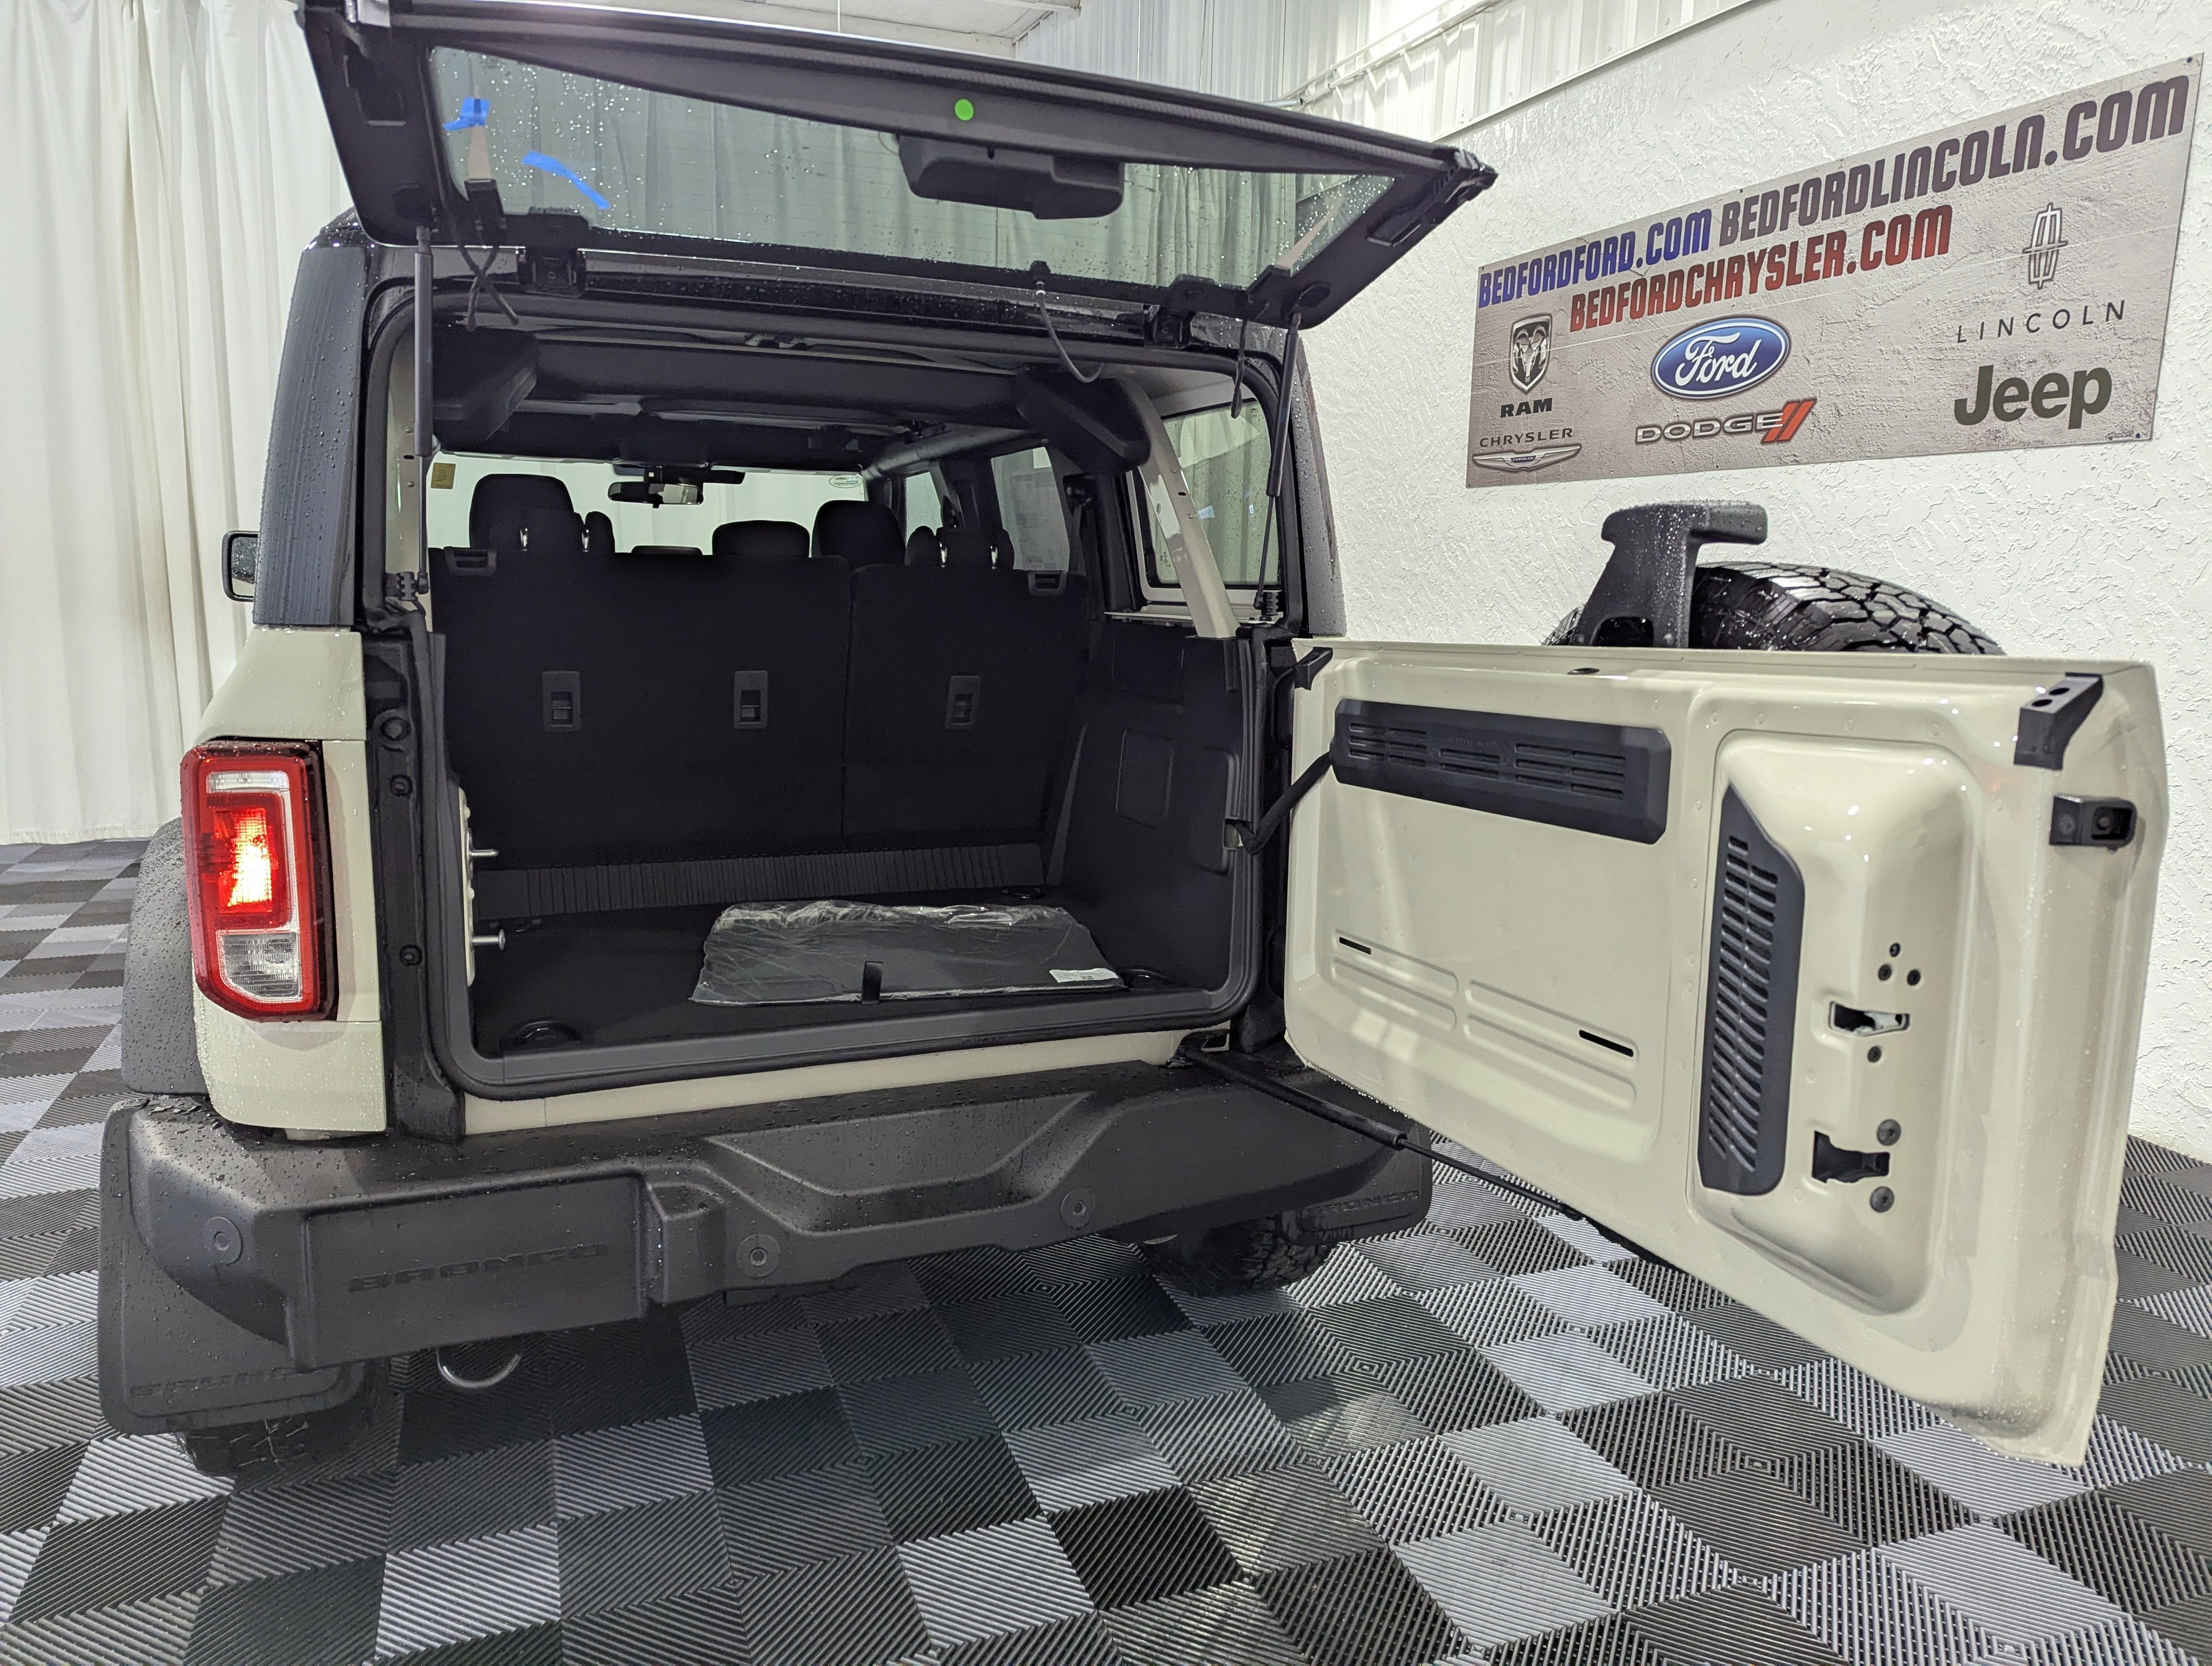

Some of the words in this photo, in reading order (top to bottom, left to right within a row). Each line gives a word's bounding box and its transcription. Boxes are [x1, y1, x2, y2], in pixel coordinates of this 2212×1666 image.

[1479, 209, 1712, 308] BEDFORDFORD.COM
[1719, 75, 2189, 246] BEDFORDLINCOLN.COM
[1570, 204, 1952, 332] BEDFORDCHRYSLER.COM
[1957, 300, 2125, 343] LINCOLN
[1675, 332, 1761, 386] Ford
[1500, 398, 1553, 418] RAM
[1954, 364, 2112, 430] Jeep
[1480, 428, 1573, 447] CHRYSLER
[1636, 412, 1784, 443] DODGE
[348, 1242, 609, 1293] BRONCO
